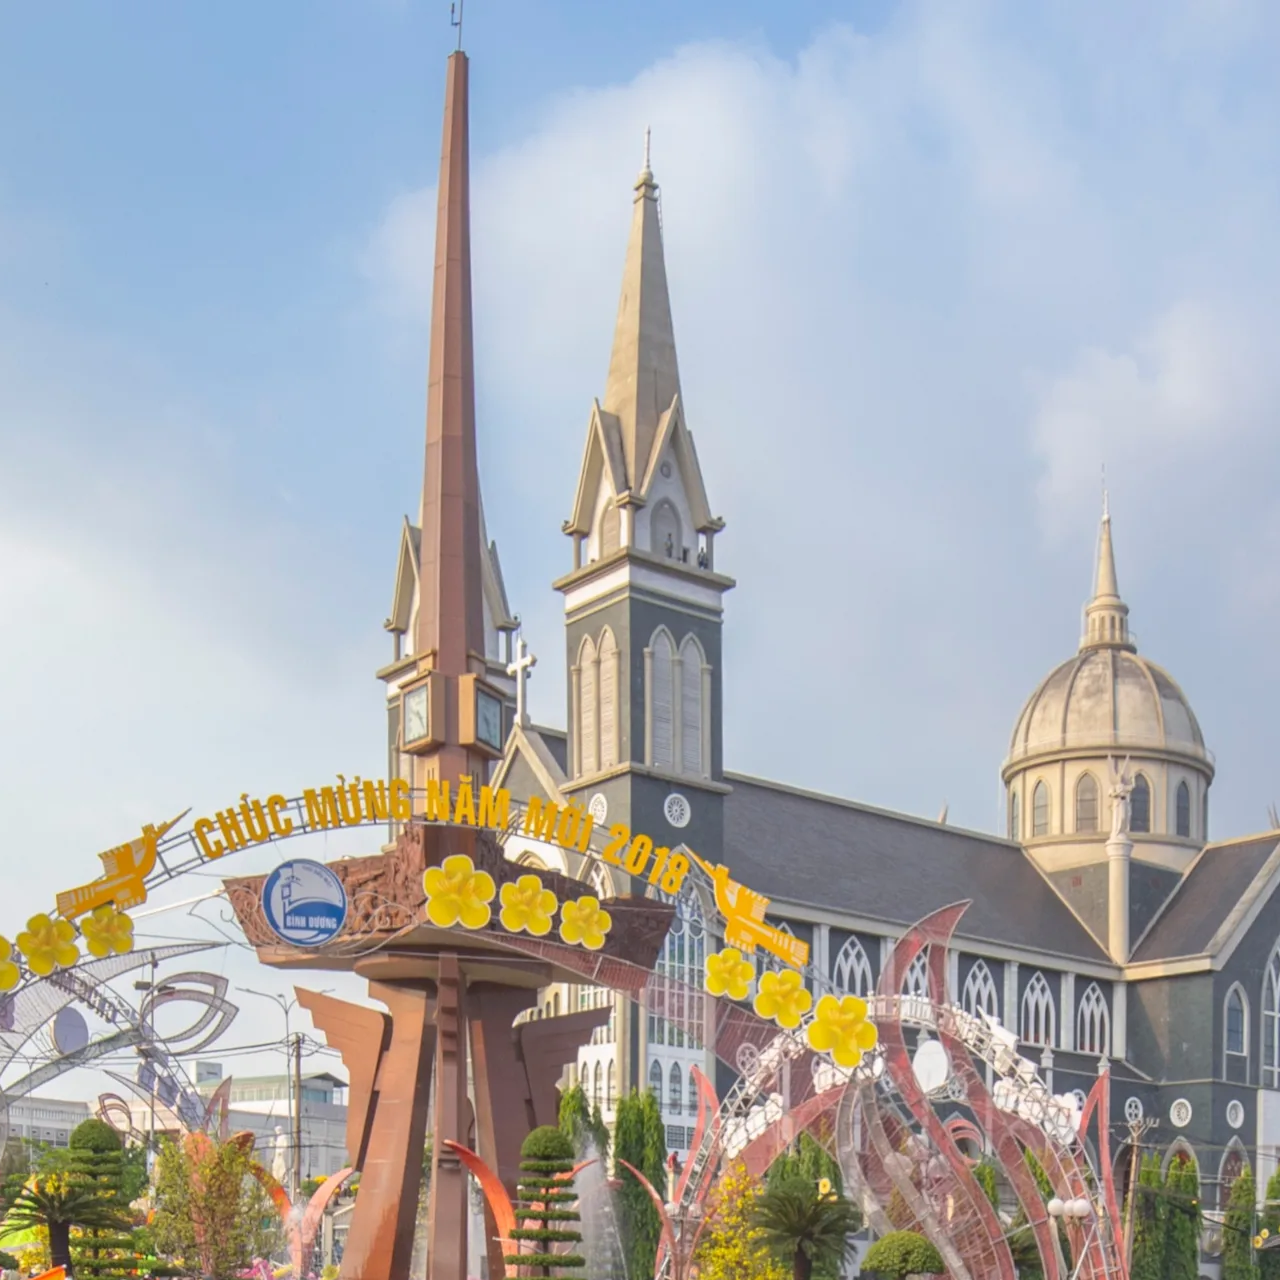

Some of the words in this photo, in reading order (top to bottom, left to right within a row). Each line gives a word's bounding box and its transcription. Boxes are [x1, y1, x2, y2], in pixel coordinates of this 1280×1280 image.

[194, 793, 293, 860] CHÚC
[303, 774, 411, 830] MỪNG
[427, 774, 511, 830] NĂM
[523, 796, 594, 852] MỚI
[602, 824, 690, 895] 2018
